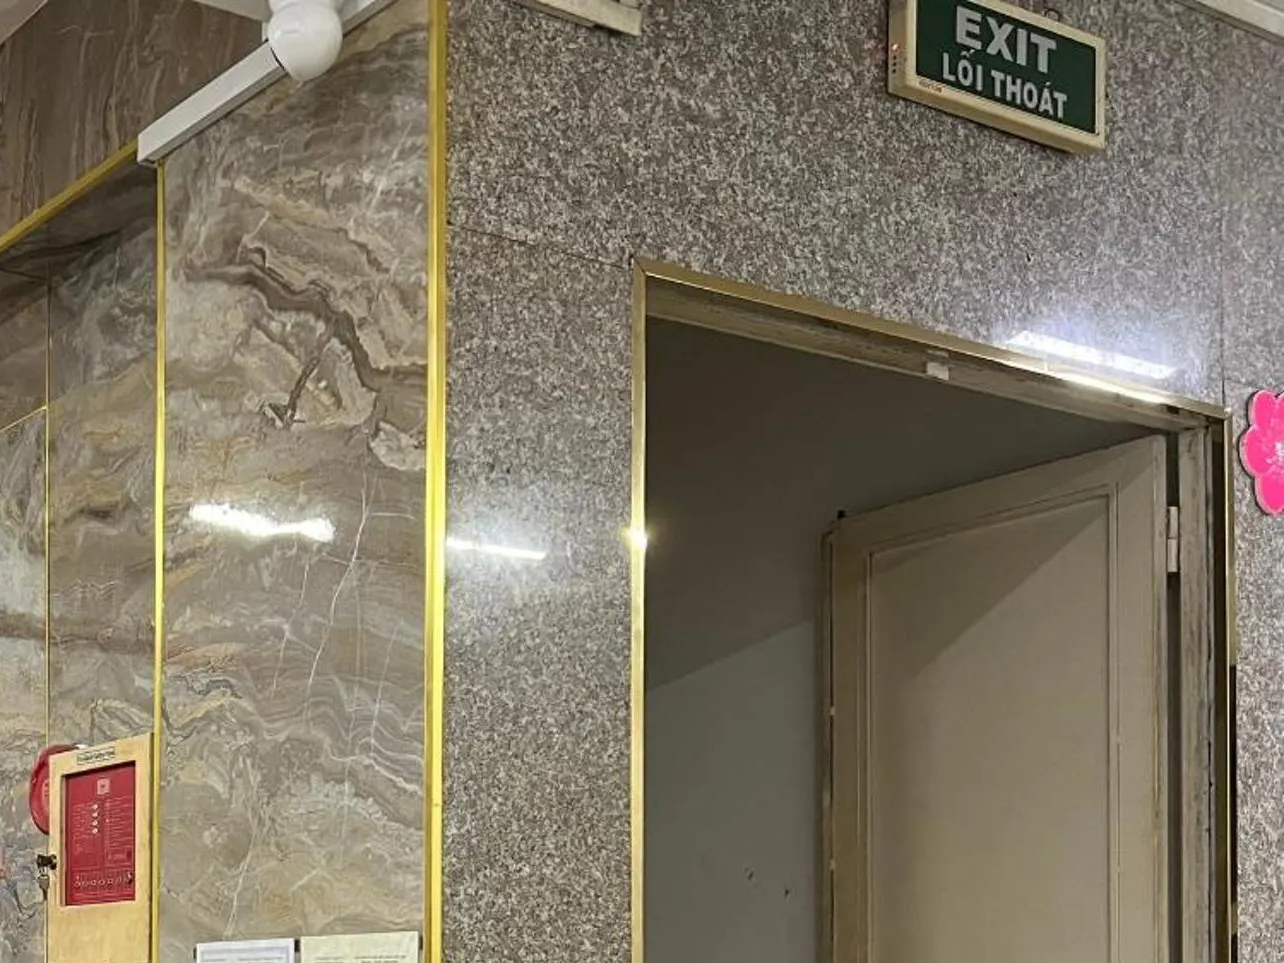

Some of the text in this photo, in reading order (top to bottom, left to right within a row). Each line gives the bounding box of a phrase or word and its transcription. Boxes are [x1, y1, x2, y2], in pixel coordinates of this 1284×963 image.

[956, 5, 1057, 74] EXIT
[942, 48, 1068, 119] LỐI THOÁT
